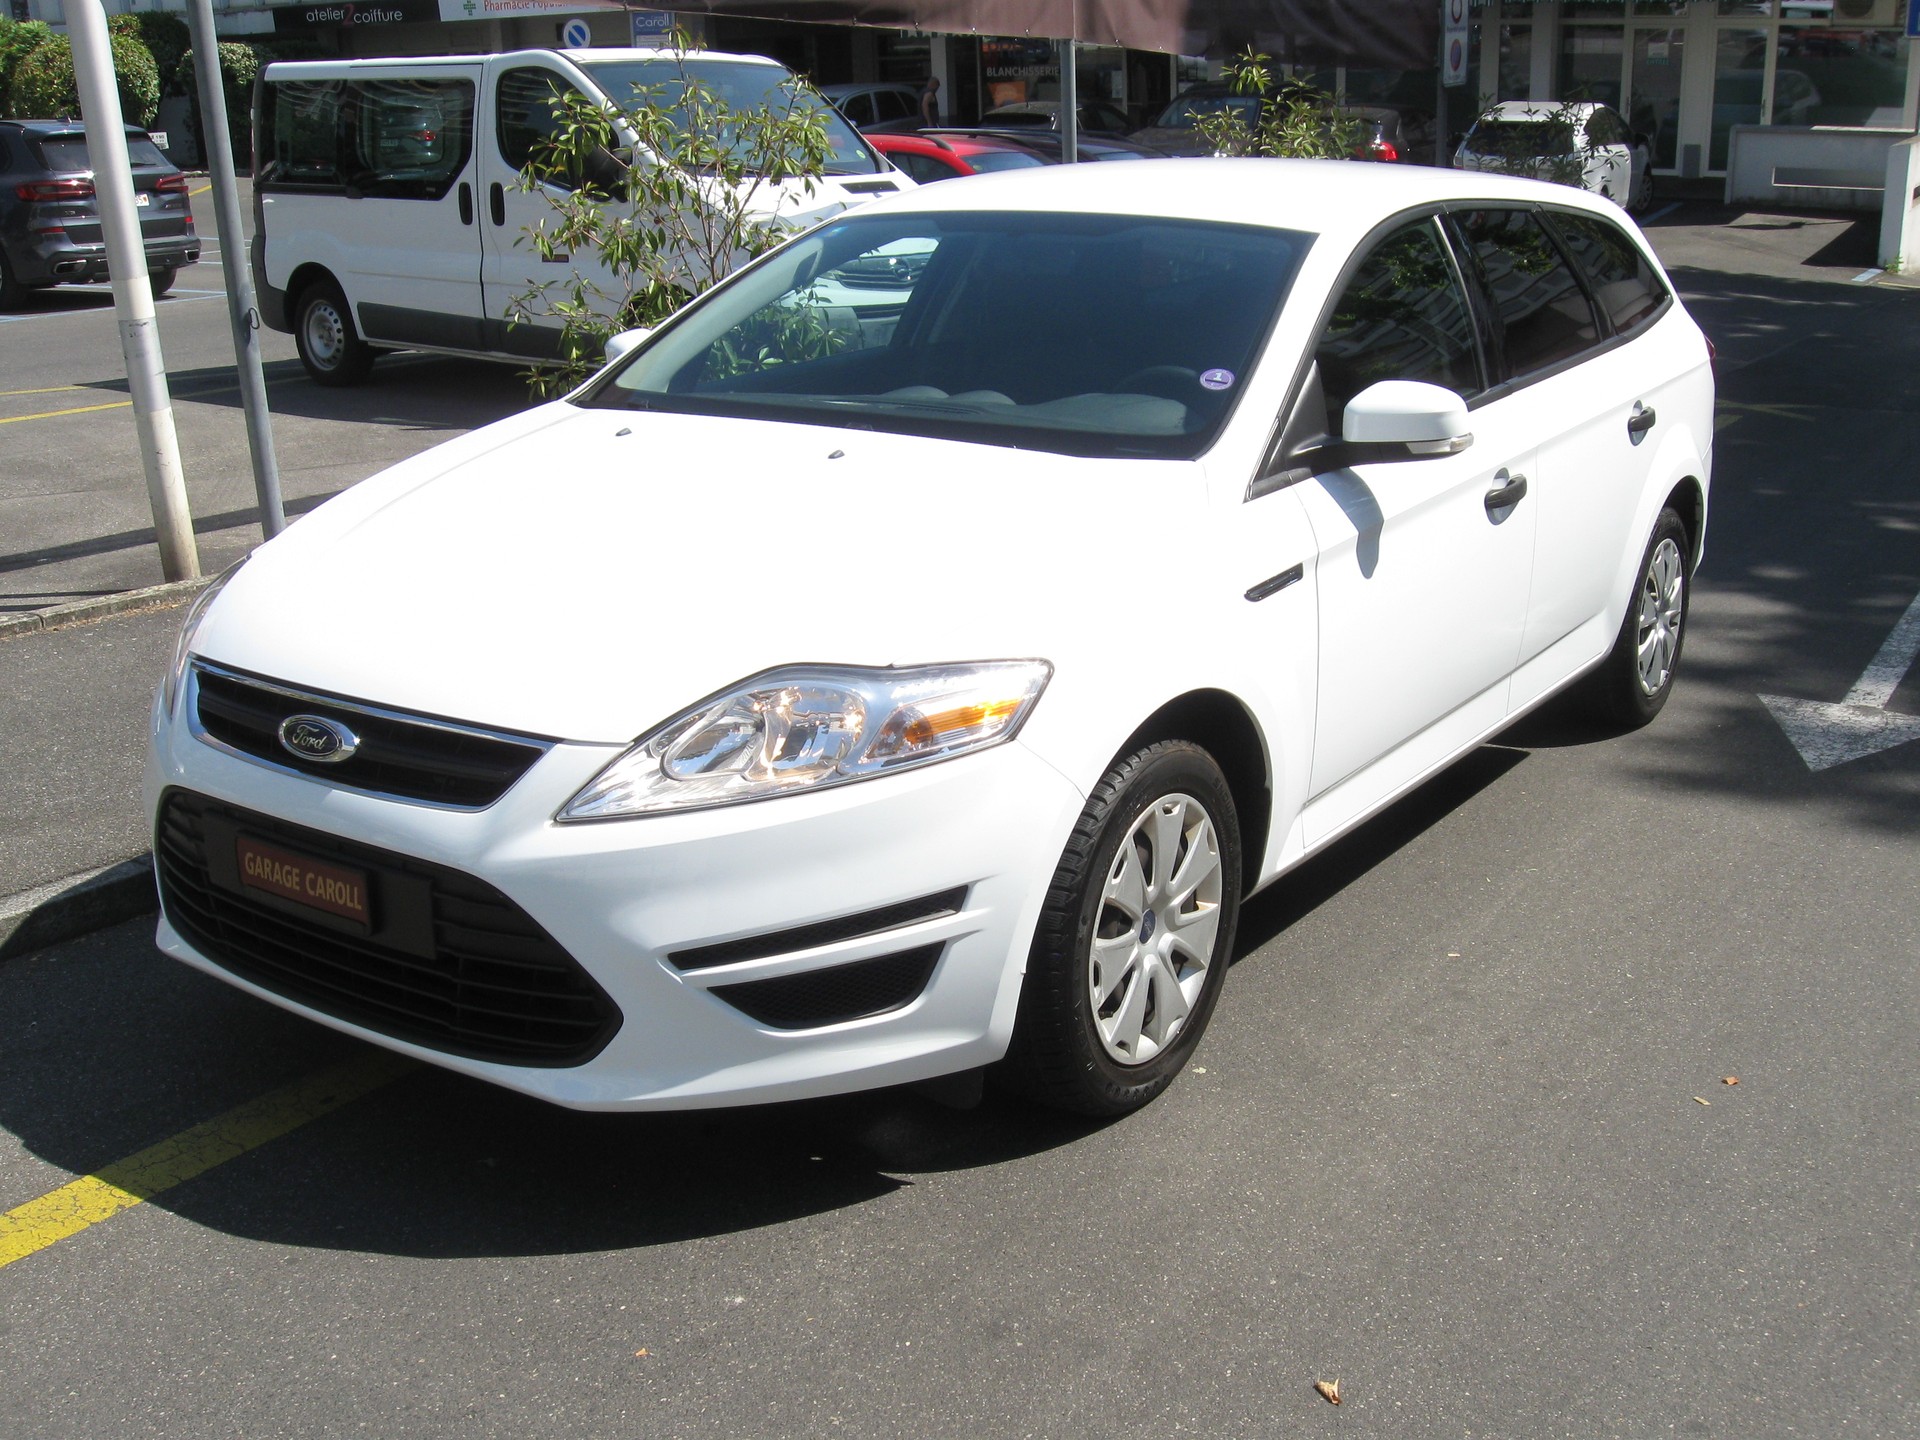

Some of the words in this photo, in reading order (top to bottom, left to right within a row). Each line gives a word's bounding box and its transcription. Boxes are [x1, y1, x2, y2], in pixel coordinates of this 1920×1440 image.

[483, 0, 530, 12] Pharmacie
[306, 8, 344, 22] atelier
[353, 9, 403, 24] coiffure
[635, 12, 670, 27] Caroll
[986, 65, 1061, 77] BLANCHISSERIE
[292, 724, 328, 750] Ford
[244, 851, 301, 891] GARAGE
[304, 872, 363, 911] CAROLL
